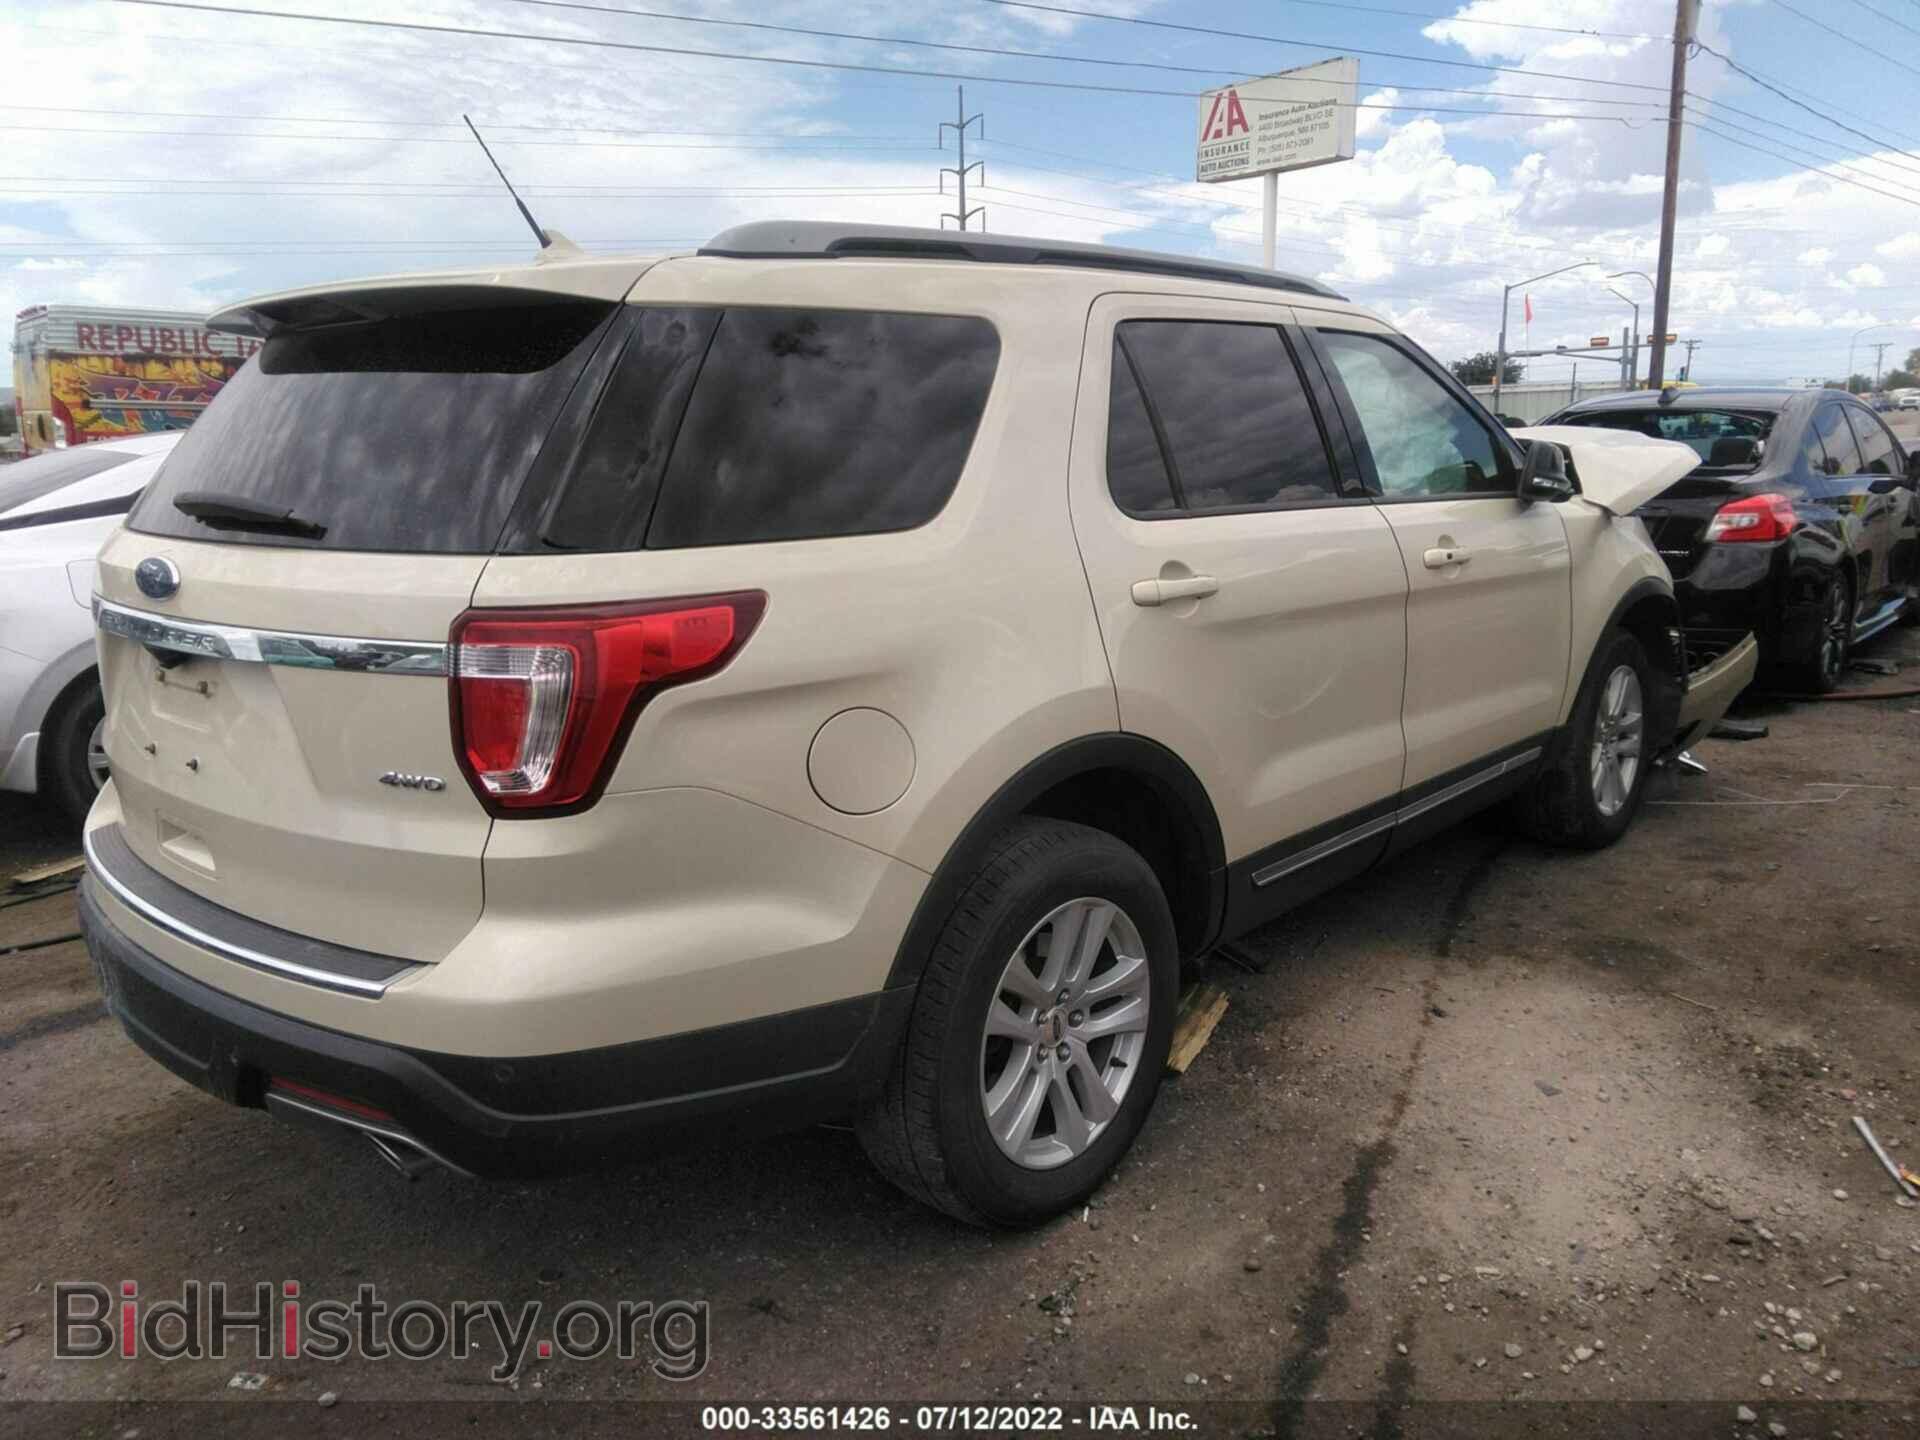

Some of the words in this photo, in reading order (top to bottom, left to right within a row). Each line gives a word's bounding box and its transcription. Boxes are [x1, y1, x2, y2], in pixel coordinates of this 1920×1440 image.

[1291, 104, 1306, 114] Auto
[1304, 111, 1323, 122] BLVD
[1200, 141, 1250, 160] INSURANCE
[1200, 162, 1217, 173] AUTO
[1218, 157, 1249, 169] AUCTIONS
[77, 322, 223, 355] REPUBLIC
[380, 771, 447, 792] 4WD
